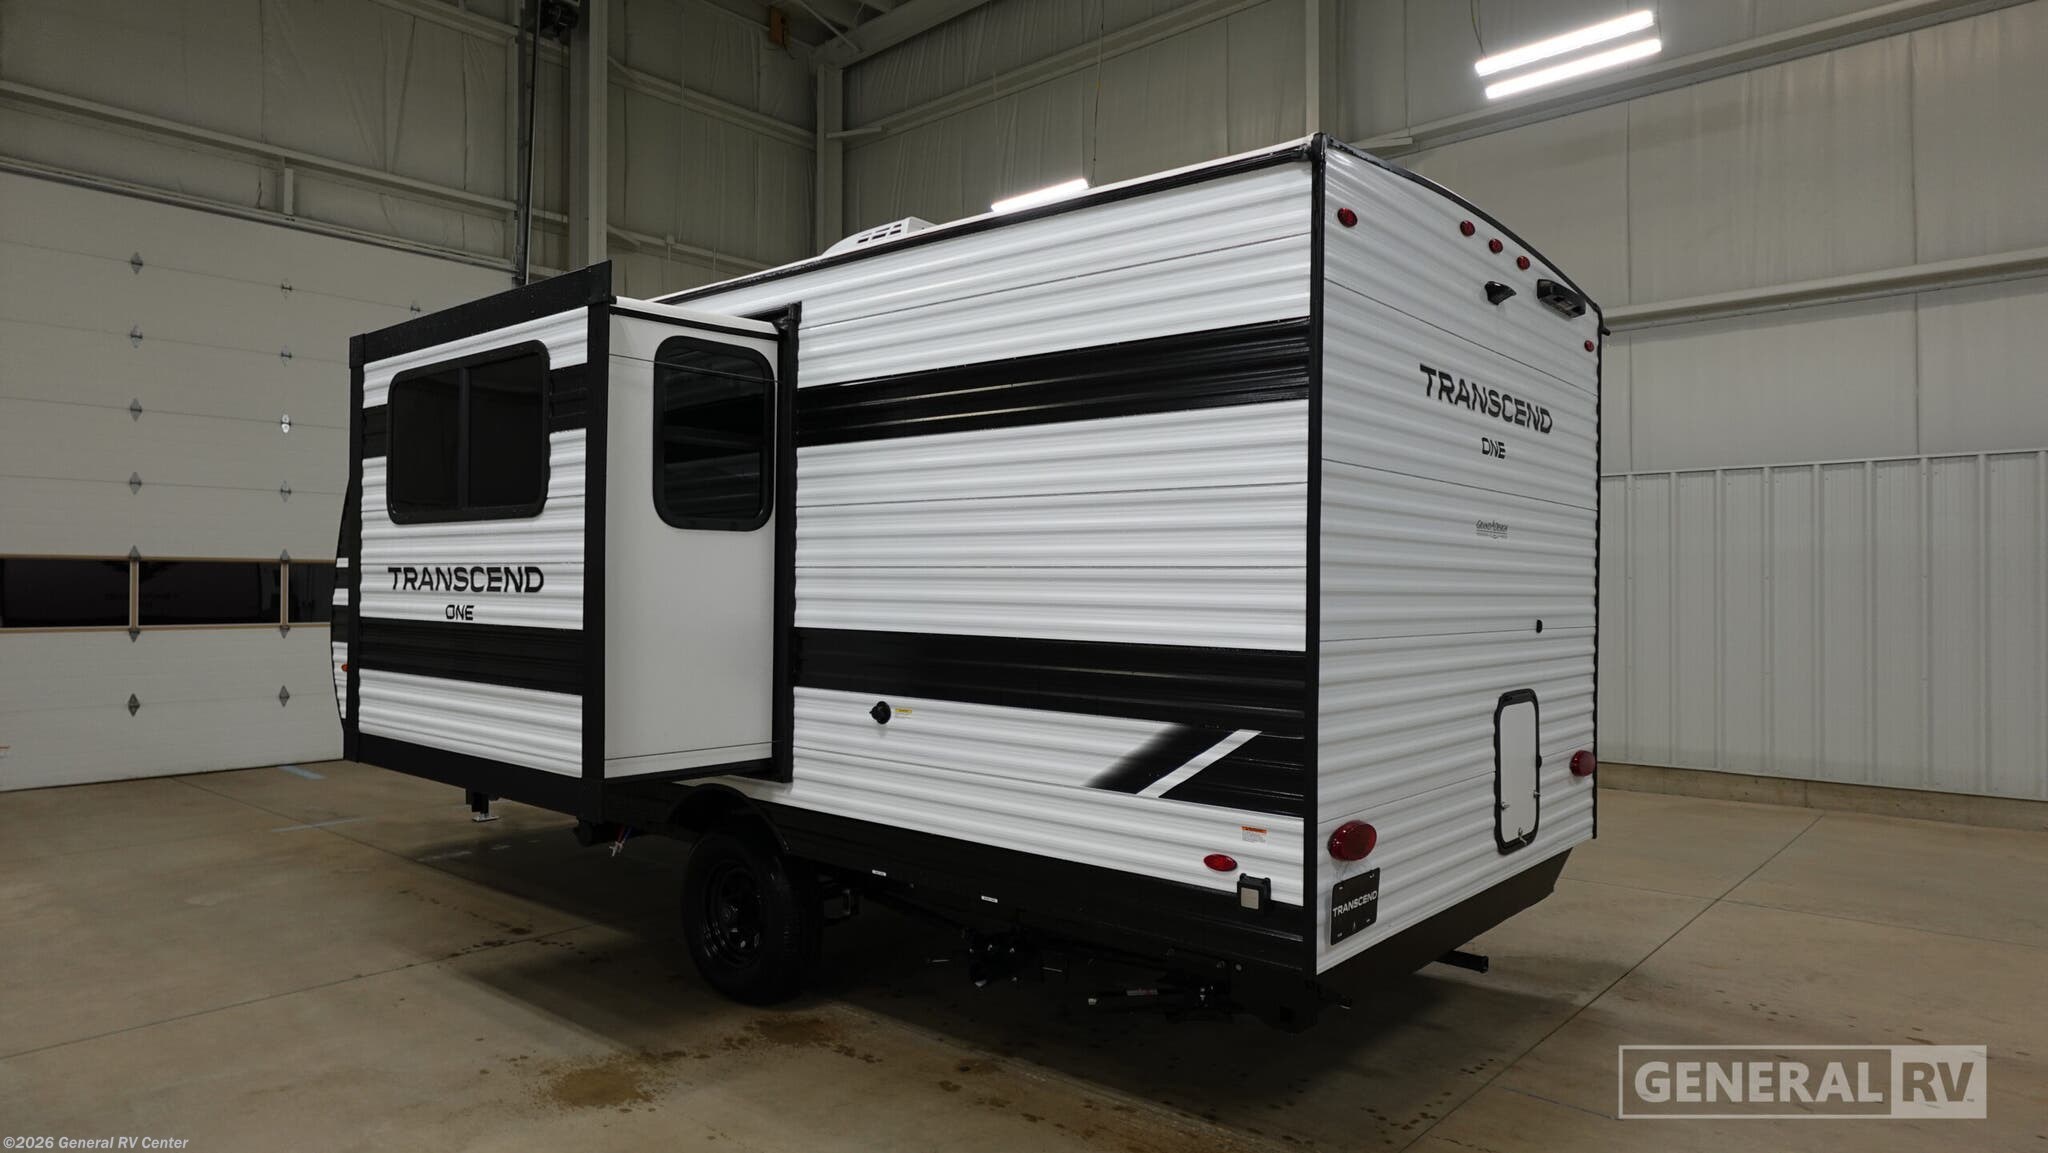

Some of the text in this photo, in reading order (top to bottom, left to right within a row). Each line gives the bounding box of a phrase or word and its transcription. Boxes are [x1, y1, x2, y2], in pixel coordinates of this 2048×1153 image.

[1419, 363, 1553, 434] TRANSCEND
[1481, 437, 1506, 459] ONE
[387, 566, 544, 593] TRANSCEND
[445, 604, 474, 620] ONE
[1332, 890, 1378, 917] TRANSCEND
